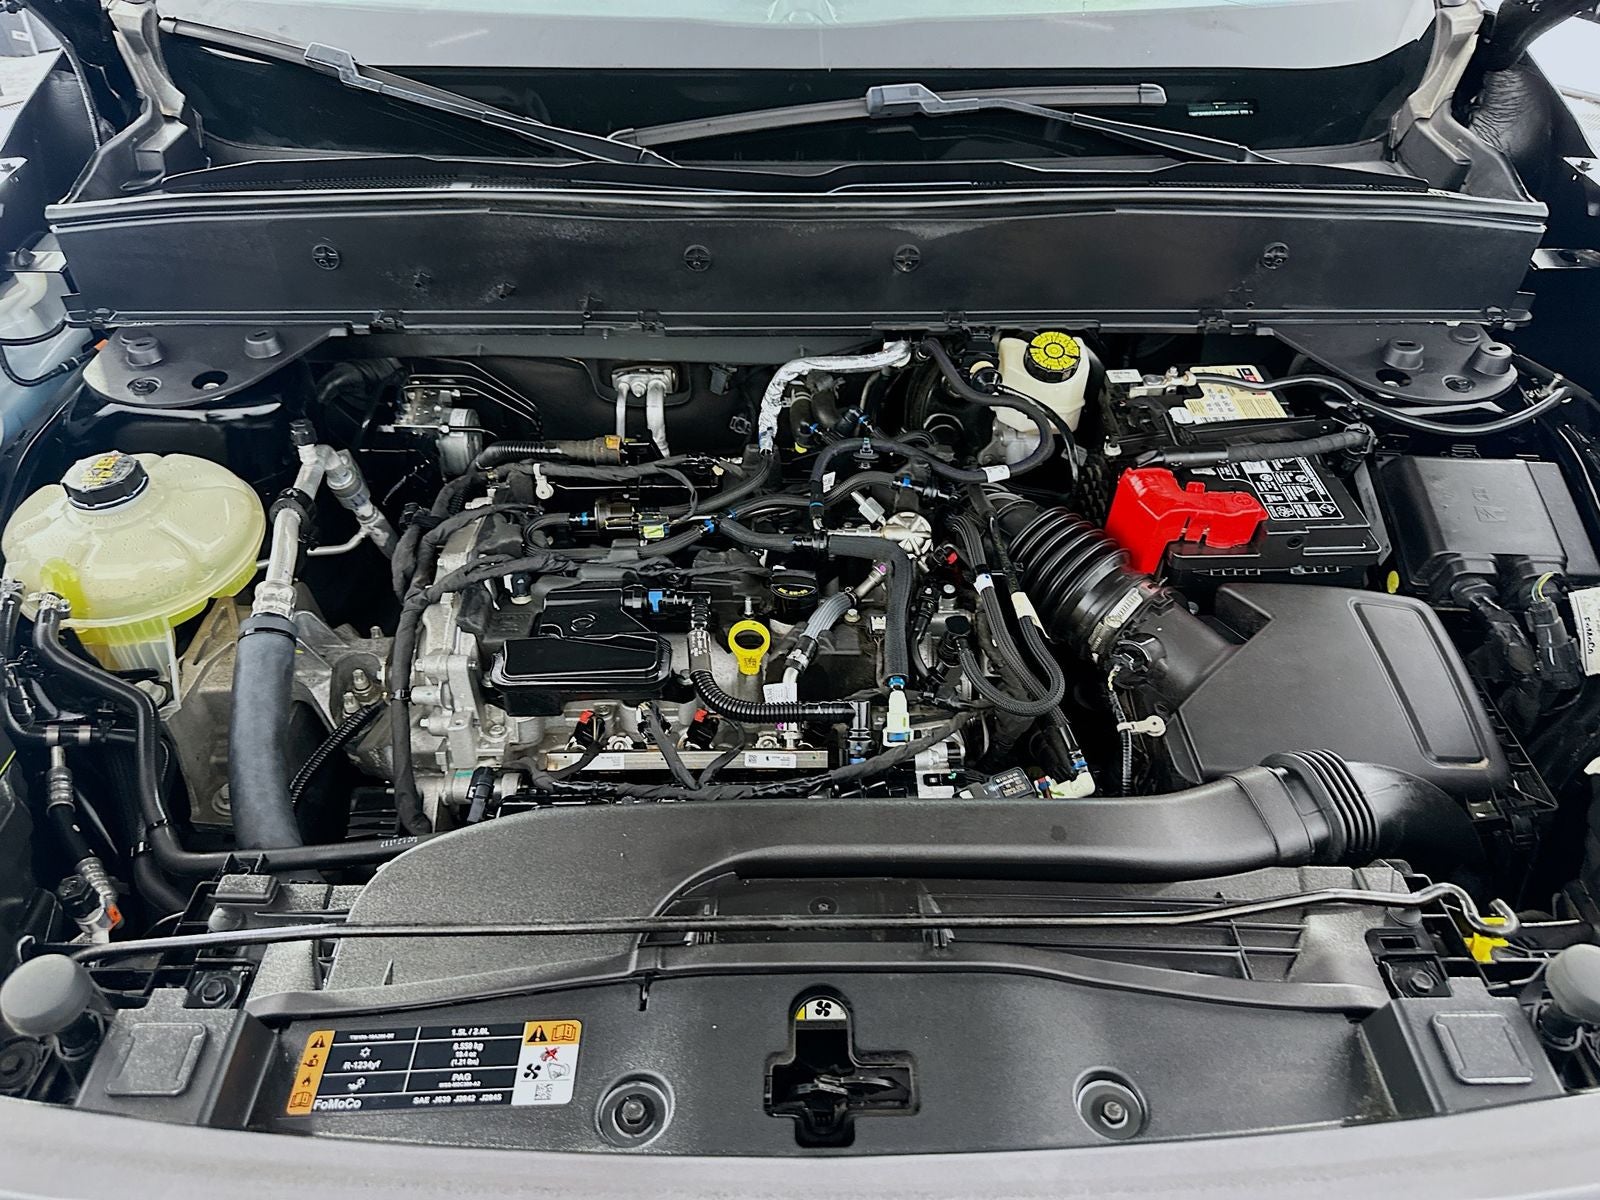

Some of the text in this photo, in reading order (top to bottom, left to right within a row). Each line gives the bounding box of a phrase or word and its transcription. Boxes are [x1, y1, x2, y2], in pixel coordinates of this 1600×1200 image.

[1584, 616, 1595, 655] FoMoCo
[473, 1027, 490, 1036] 2.0L
[473, 1041, 484, 1052] kg
[342, 1060, 382, 1070] R-1234yf
[451, 1072, 472, 1081] PAG
[313, 1098, 362, 1110] FoMoCo
[412, 1096, 430, 1105] SAE
